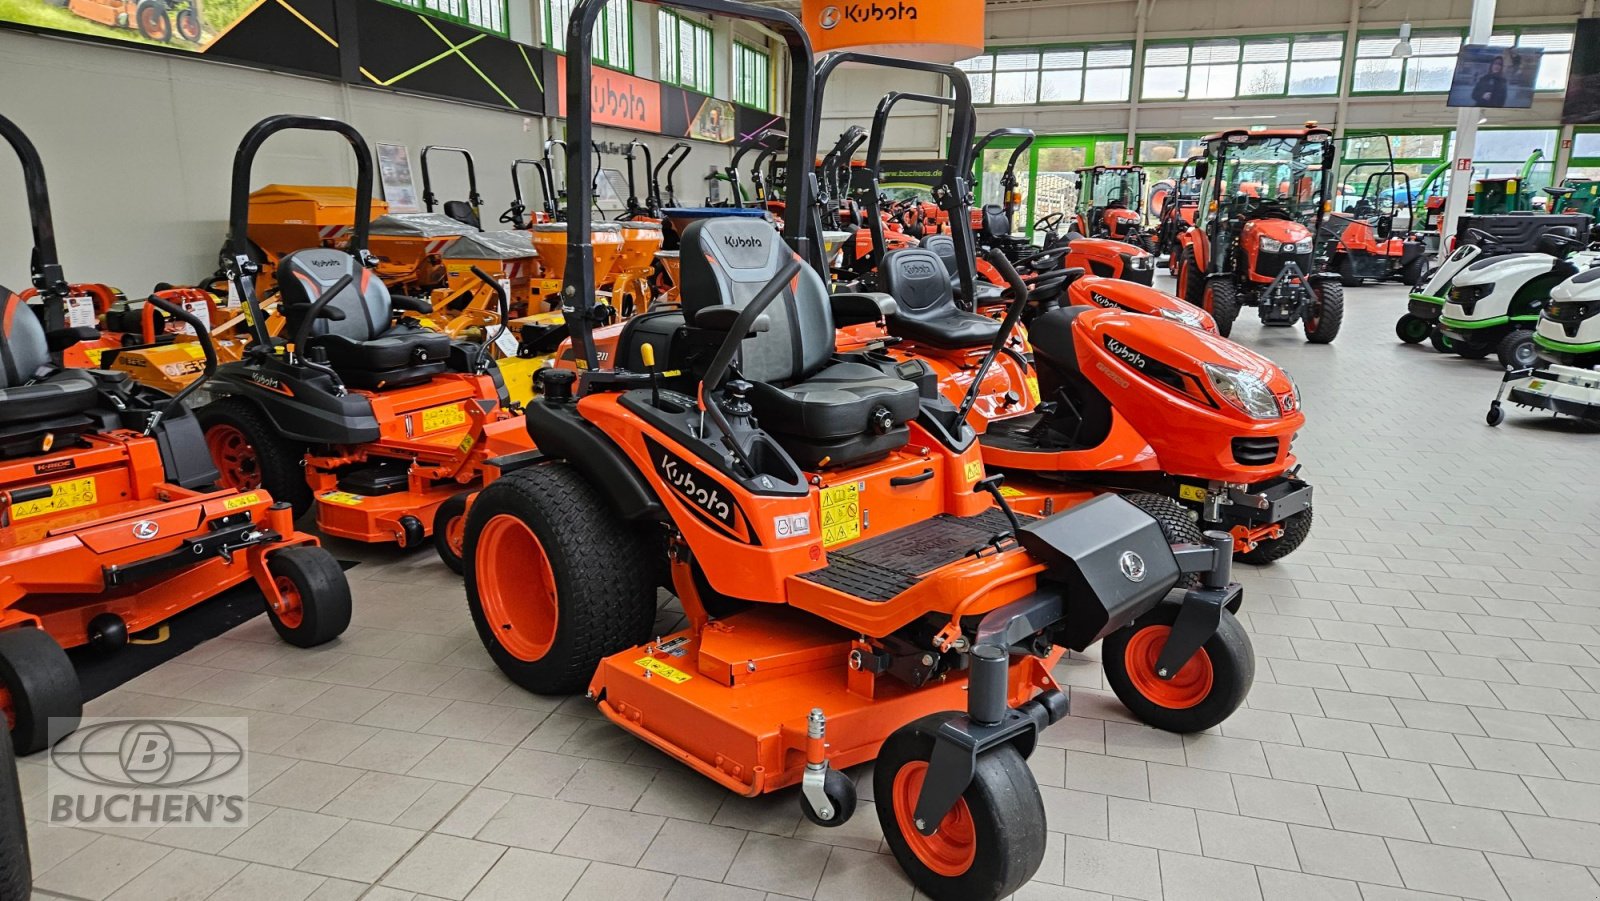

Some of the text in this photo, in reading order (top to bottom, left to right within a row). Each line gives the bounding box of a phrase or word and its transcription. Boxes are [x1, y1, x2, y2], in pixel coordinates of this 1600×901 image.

[845, 2, 917, 22] Kubota
[591, 74, 646, 121] ubota
[724, 235, 762, 248] Kubota
[1107, 338, 1147, 369] Kubota
[252, 372, 278, 388] Kubota
[661, 454, 730, 520] Kubota
